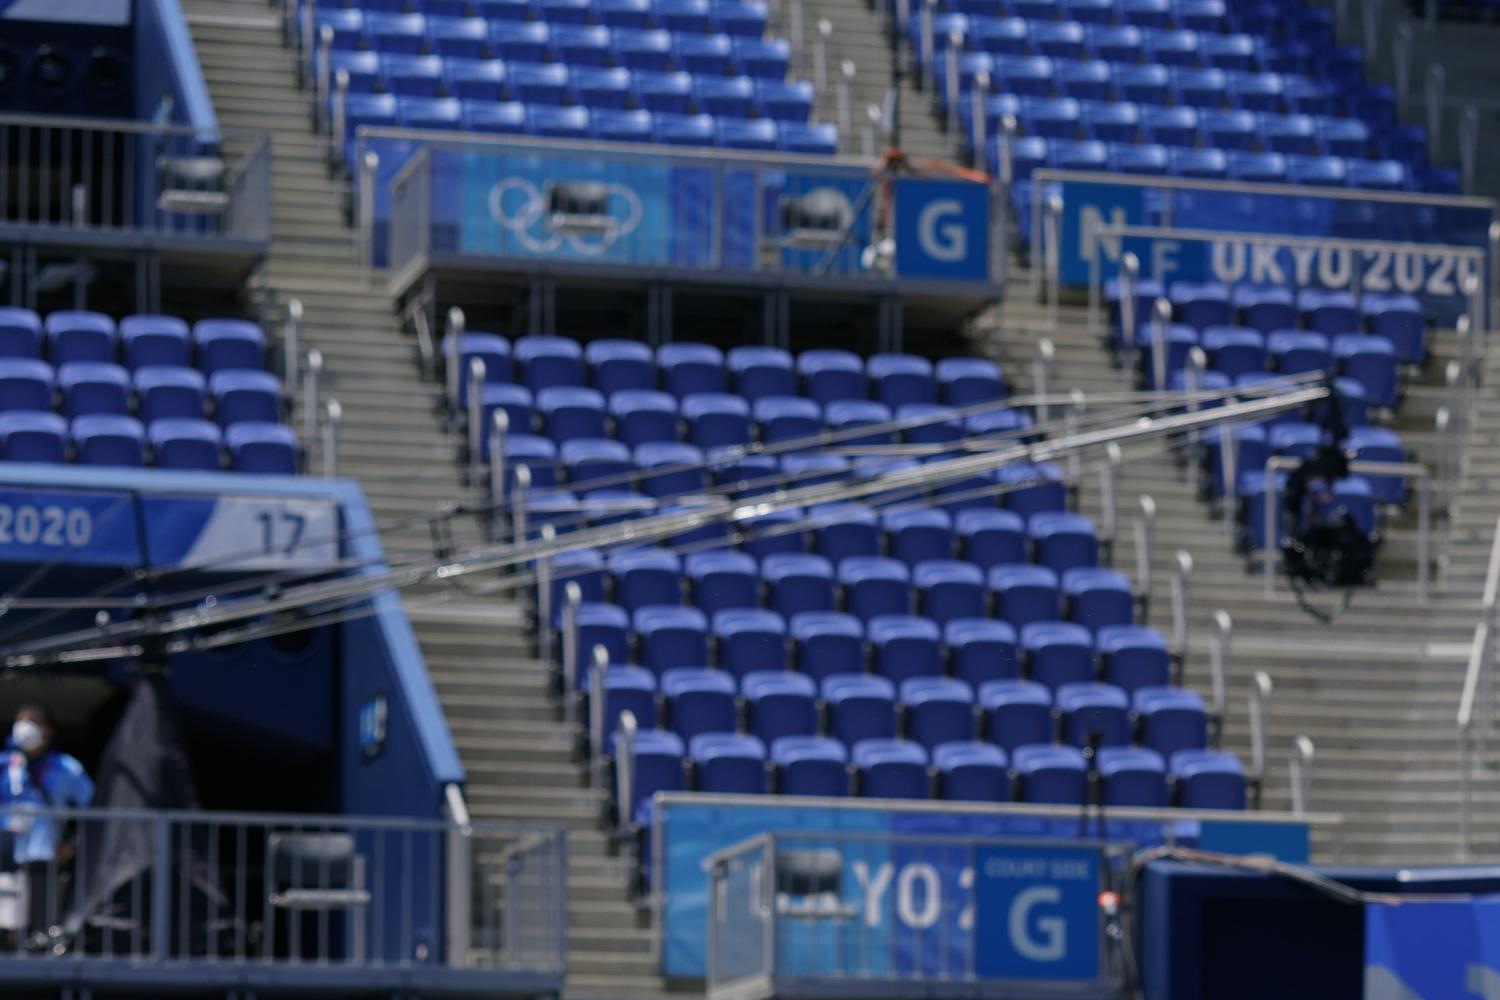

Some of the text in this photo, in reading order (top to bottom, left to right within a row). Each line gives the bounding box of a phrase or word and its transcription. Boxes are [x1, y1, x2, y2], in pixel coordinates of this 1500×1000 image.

[917, 200, 967, 262] G
[1078, 203, 1128, 263] N
[256, 510, 306, 560] 17
[985, 856, 1089, 881] COURT SIDE
[1007, 885, 1068, 962] G
